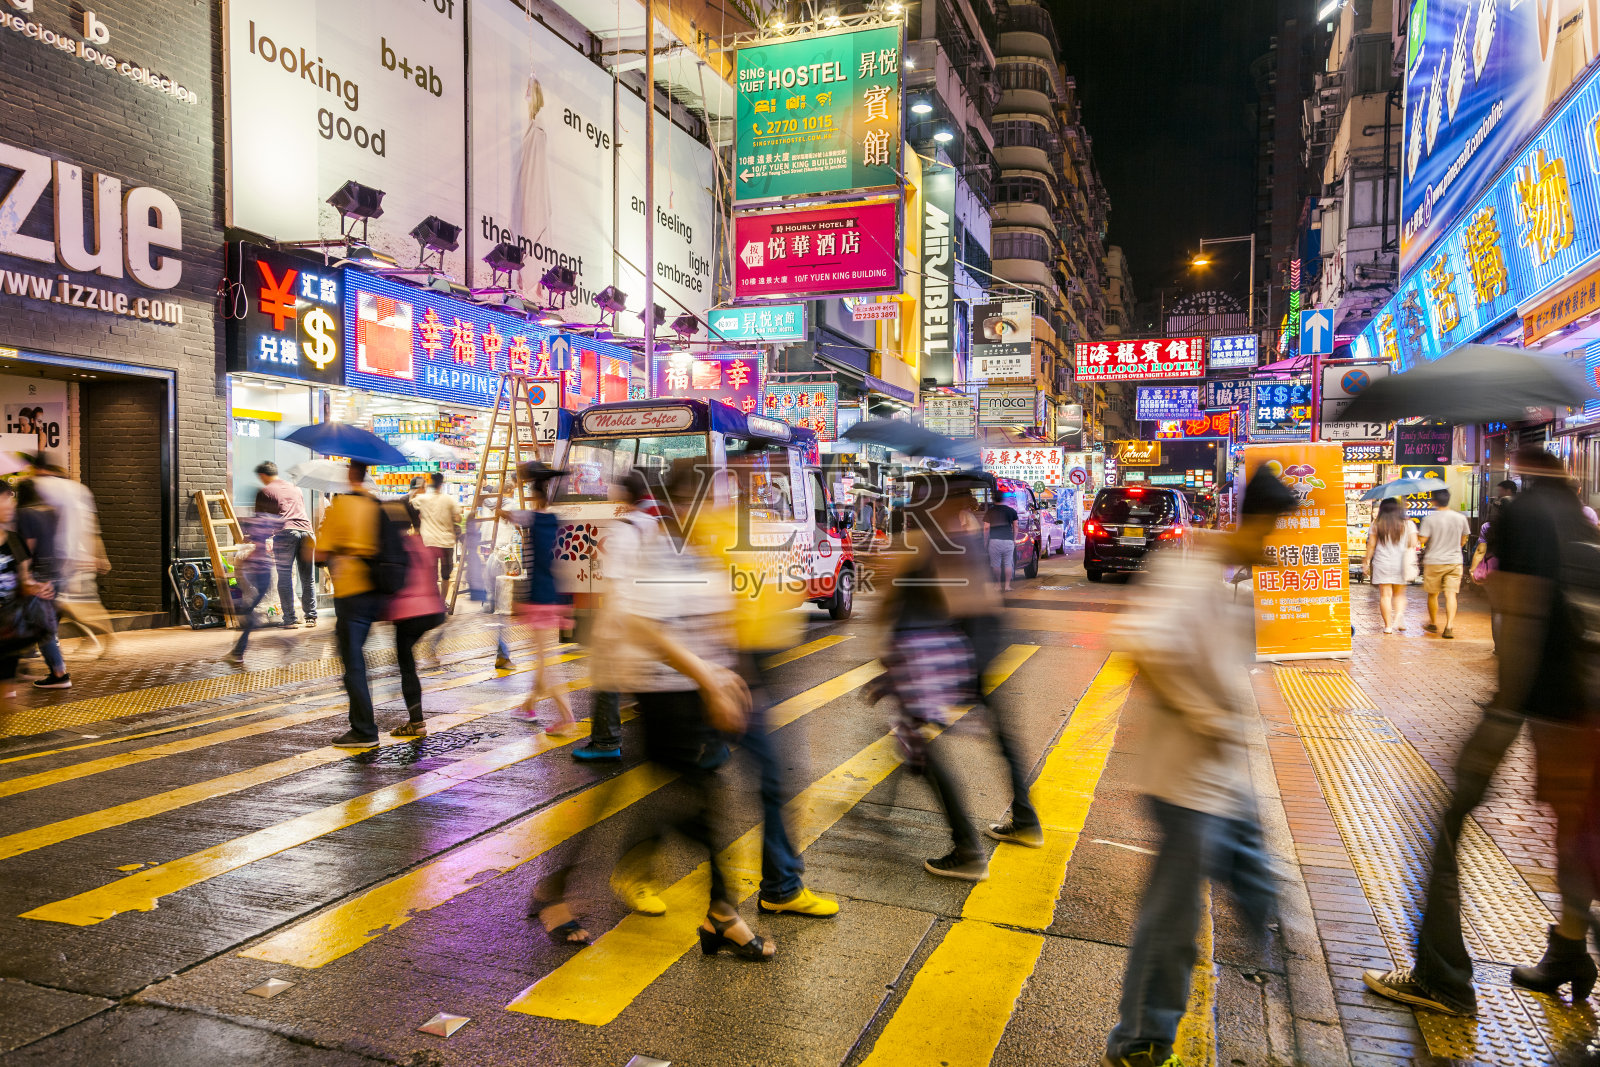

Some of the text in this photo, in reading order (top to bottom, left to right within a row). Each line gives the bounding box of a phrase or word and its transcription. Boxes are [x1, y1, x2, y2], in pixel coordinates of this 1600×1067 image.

[76, 42, 117, 69] love
[117, 62, 198, 104] collection
[249, 20, 359, 112] looking
[381, 37, 443, 97] b+ab
[740, 67, 765, 81] SING
[740, 61, 847, 93] YUET HOSTEL
[318, 107, 386, 158] good
[563, 107, 611, 150] an eye
[767, 115, 833, 134] 2770 1015
[769, 162, 789, 171] YUEN
[792, 160, 809, 169] KING
[812, 156, 847, 167] BUILDING
[657, 205, 692, 244] feeling
[785, 223, 816, 232] HOURLY
[818, 220, 844, 229] HOTEL
[481, 215, 583, 277] the moment
[688, 251, 710, 277] light
[657, 260, 703, 293] embrace
[794, 274, 809, 283] 10/F
[810, 272, 831, 282] YUEN
[832, 270, 850, 280] KING
[852, 268, 887, 279] BUILDING
[1089, 340, 1189, 364] 海龍賓館
[1077, 361, 1202, 374] HOI LOON HOTEL
[989, 397, 1026, 407] moca
[542, 411, 549, 421] 7
[594, 413, 678, 427] Mobile Softee
[543, 428, 556, 439] 12
[1324, 422, 1383, 437] midnight 12
[1259, 569, 1342, 591] 旺角分店
